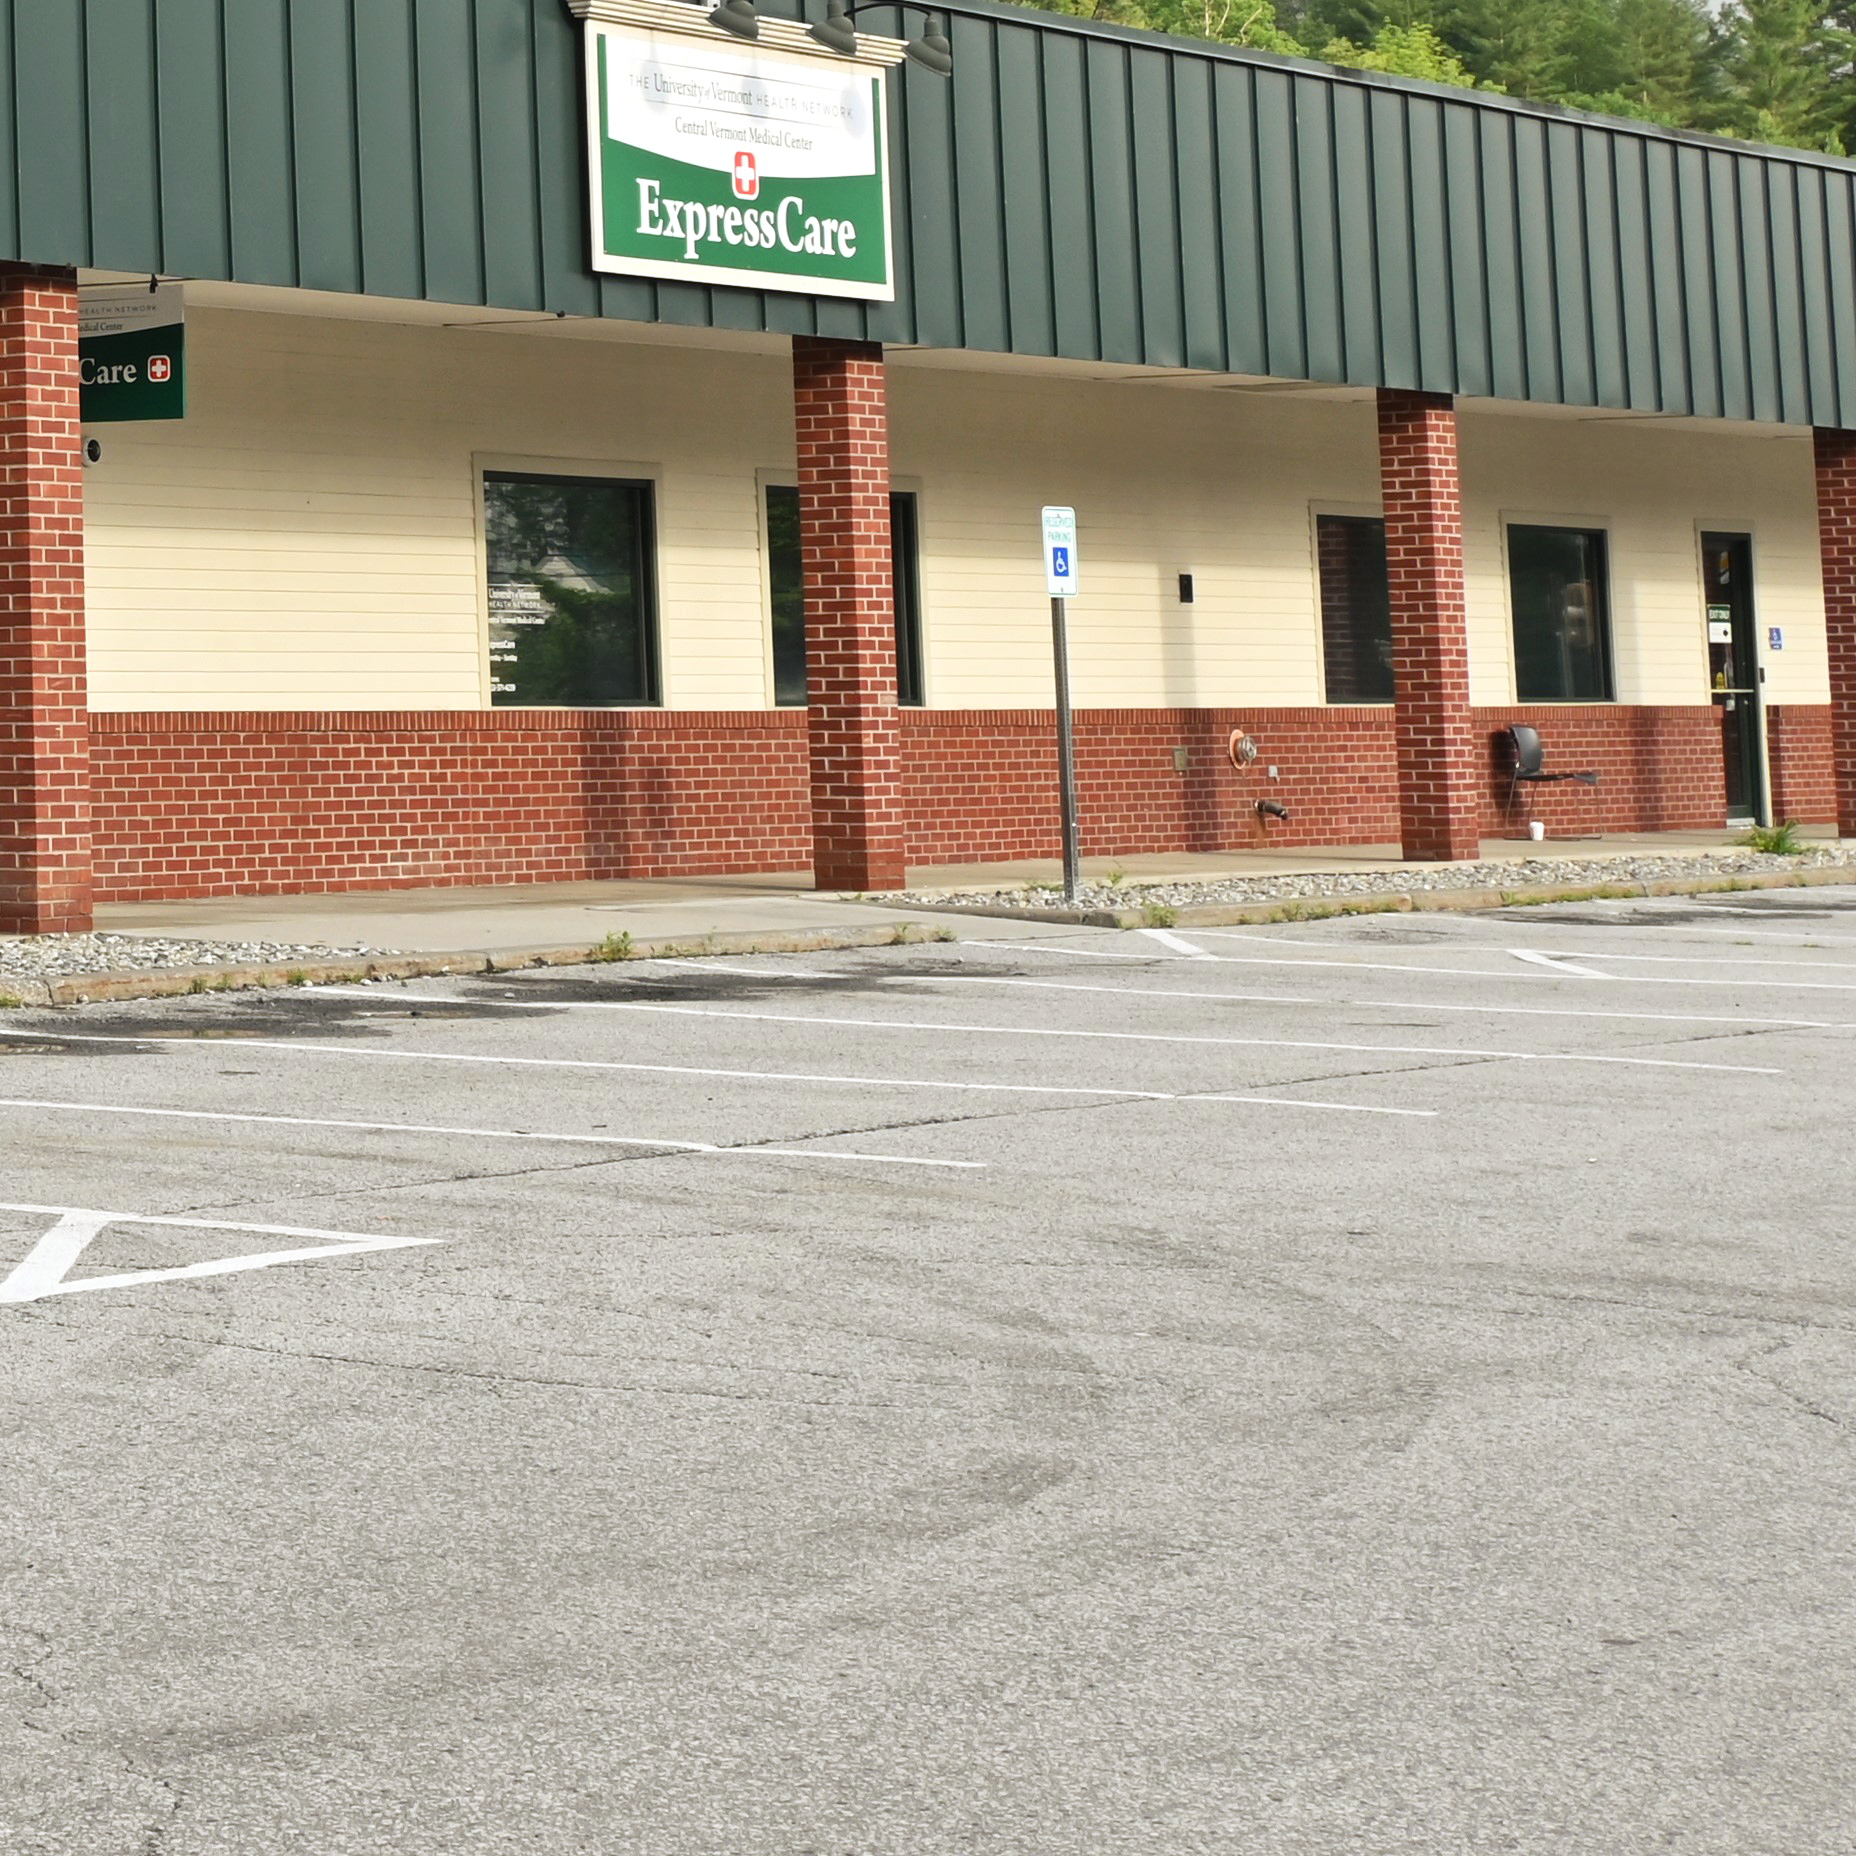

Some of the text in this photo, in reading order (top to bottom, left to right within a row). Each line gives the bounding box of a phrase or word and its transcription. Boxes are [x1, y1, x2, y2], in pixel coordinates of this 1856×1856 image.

[629, 73, 650, 91] THE
[654, 72, 705, 101] University
[711, 80, 753, 106] Vermont
[756, 94, 798, 111] HEALTH
[802, 100, 854, 119] NETWORK
[675, 116, 813, 152] Central Vermont Medical Center
[635, 177, 857, 260] ExpressCare
[115, 304, 157, 314] NETWORK
[78, 322, 123, 333] edical Center
